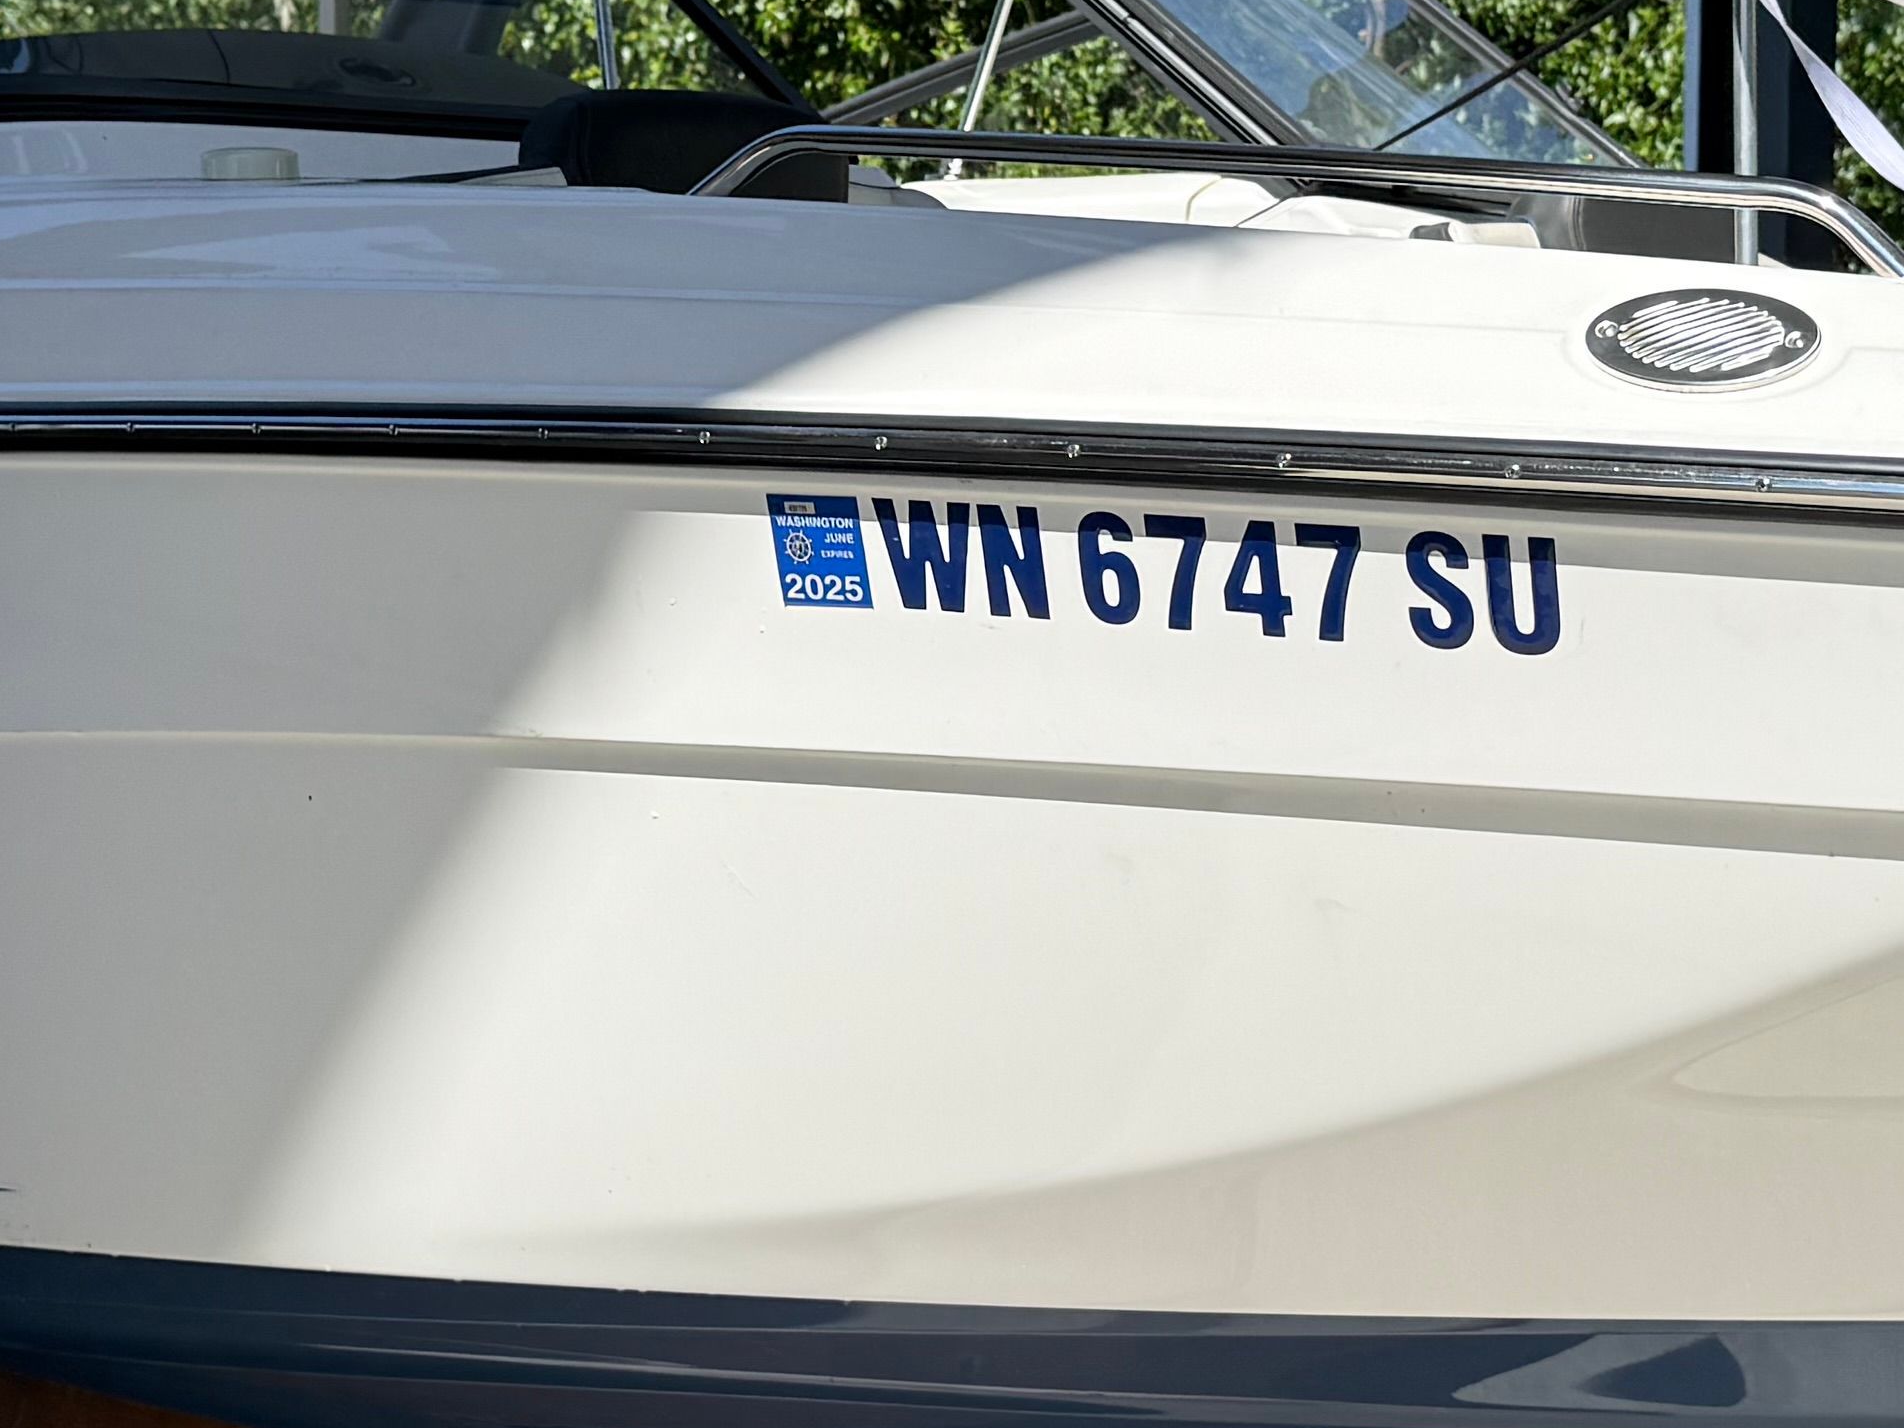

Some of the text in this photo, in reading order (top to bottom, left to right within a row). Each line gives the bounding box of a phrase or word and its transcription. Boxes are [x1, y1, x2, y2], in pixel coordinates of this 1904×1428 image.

[774, 515, 854, 529] WASHINGTON
[824, 532, 855, 544] JUNE
[820, 549, 854, 559] EXPIRES
[872, 497, 1560, 655] WN 6747 SU
[785, 573, 864, 602] 2025
